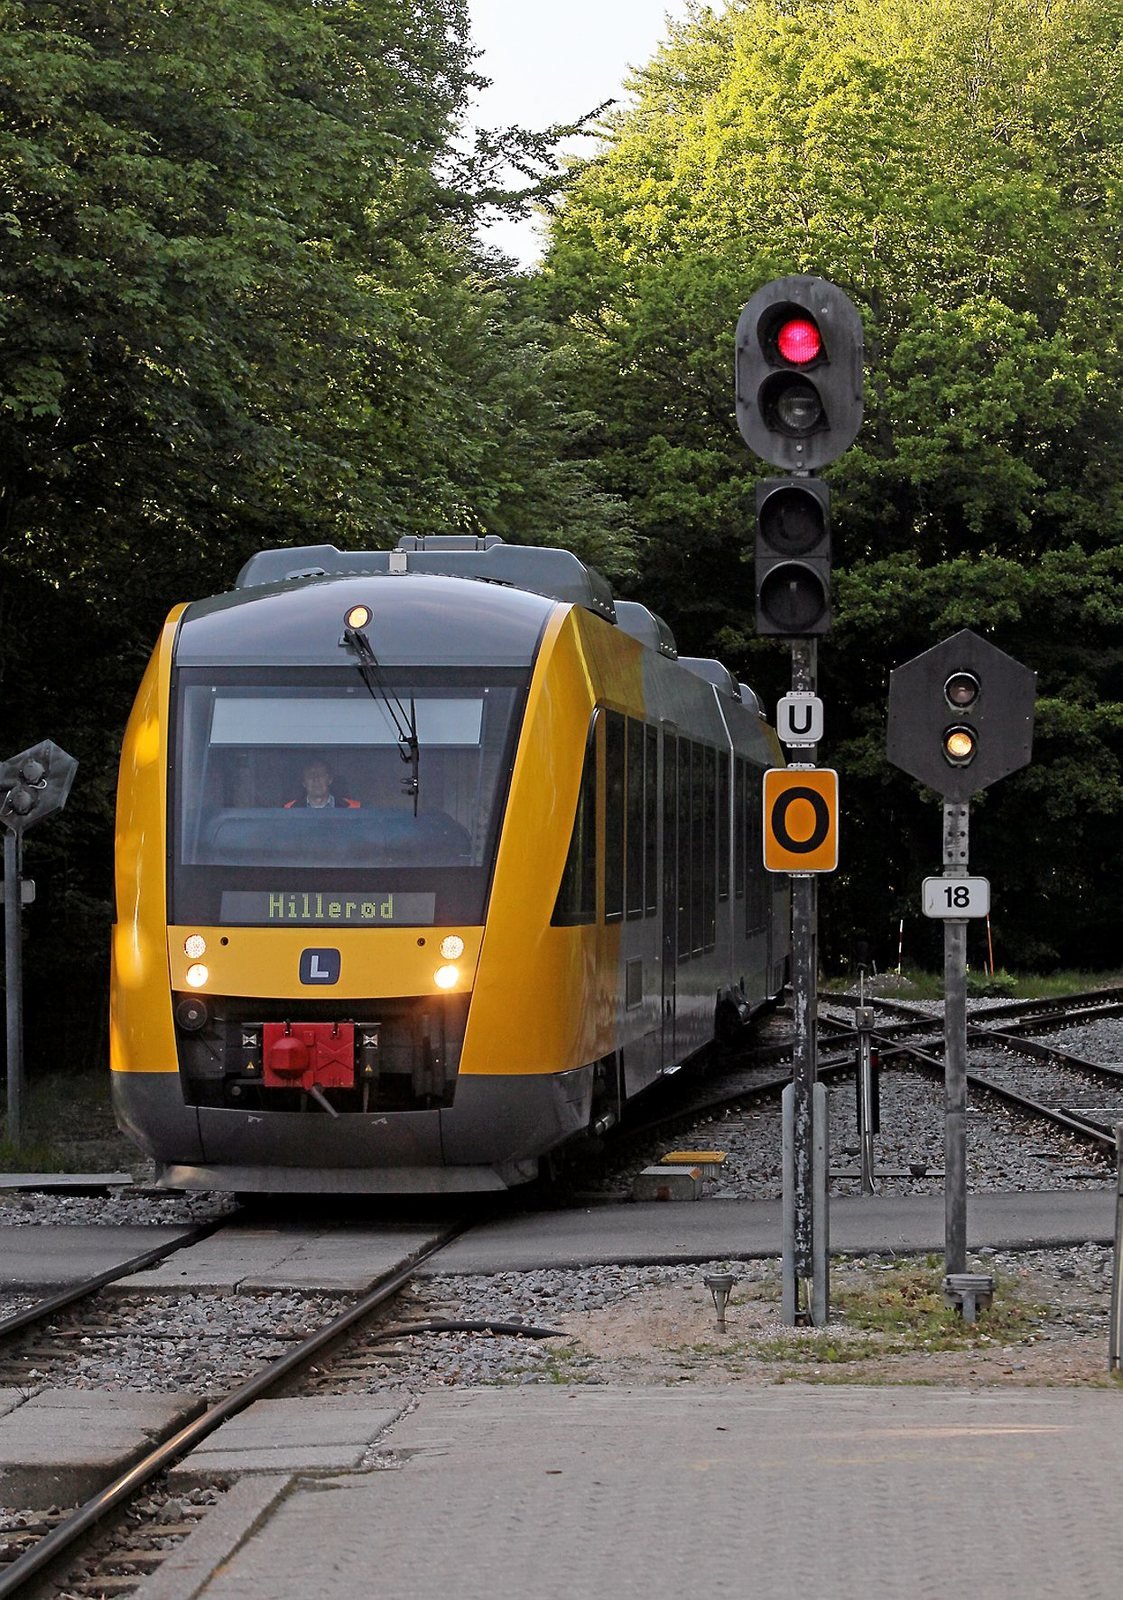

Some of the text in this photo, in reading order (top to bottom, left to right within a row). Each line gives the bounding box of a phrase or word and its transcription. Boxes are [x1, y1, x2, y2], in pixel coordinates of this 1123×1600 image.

[789, 705, 812, 734] U
[944, 886, 970, 908] 18
[310, 955, 329, 978] L
